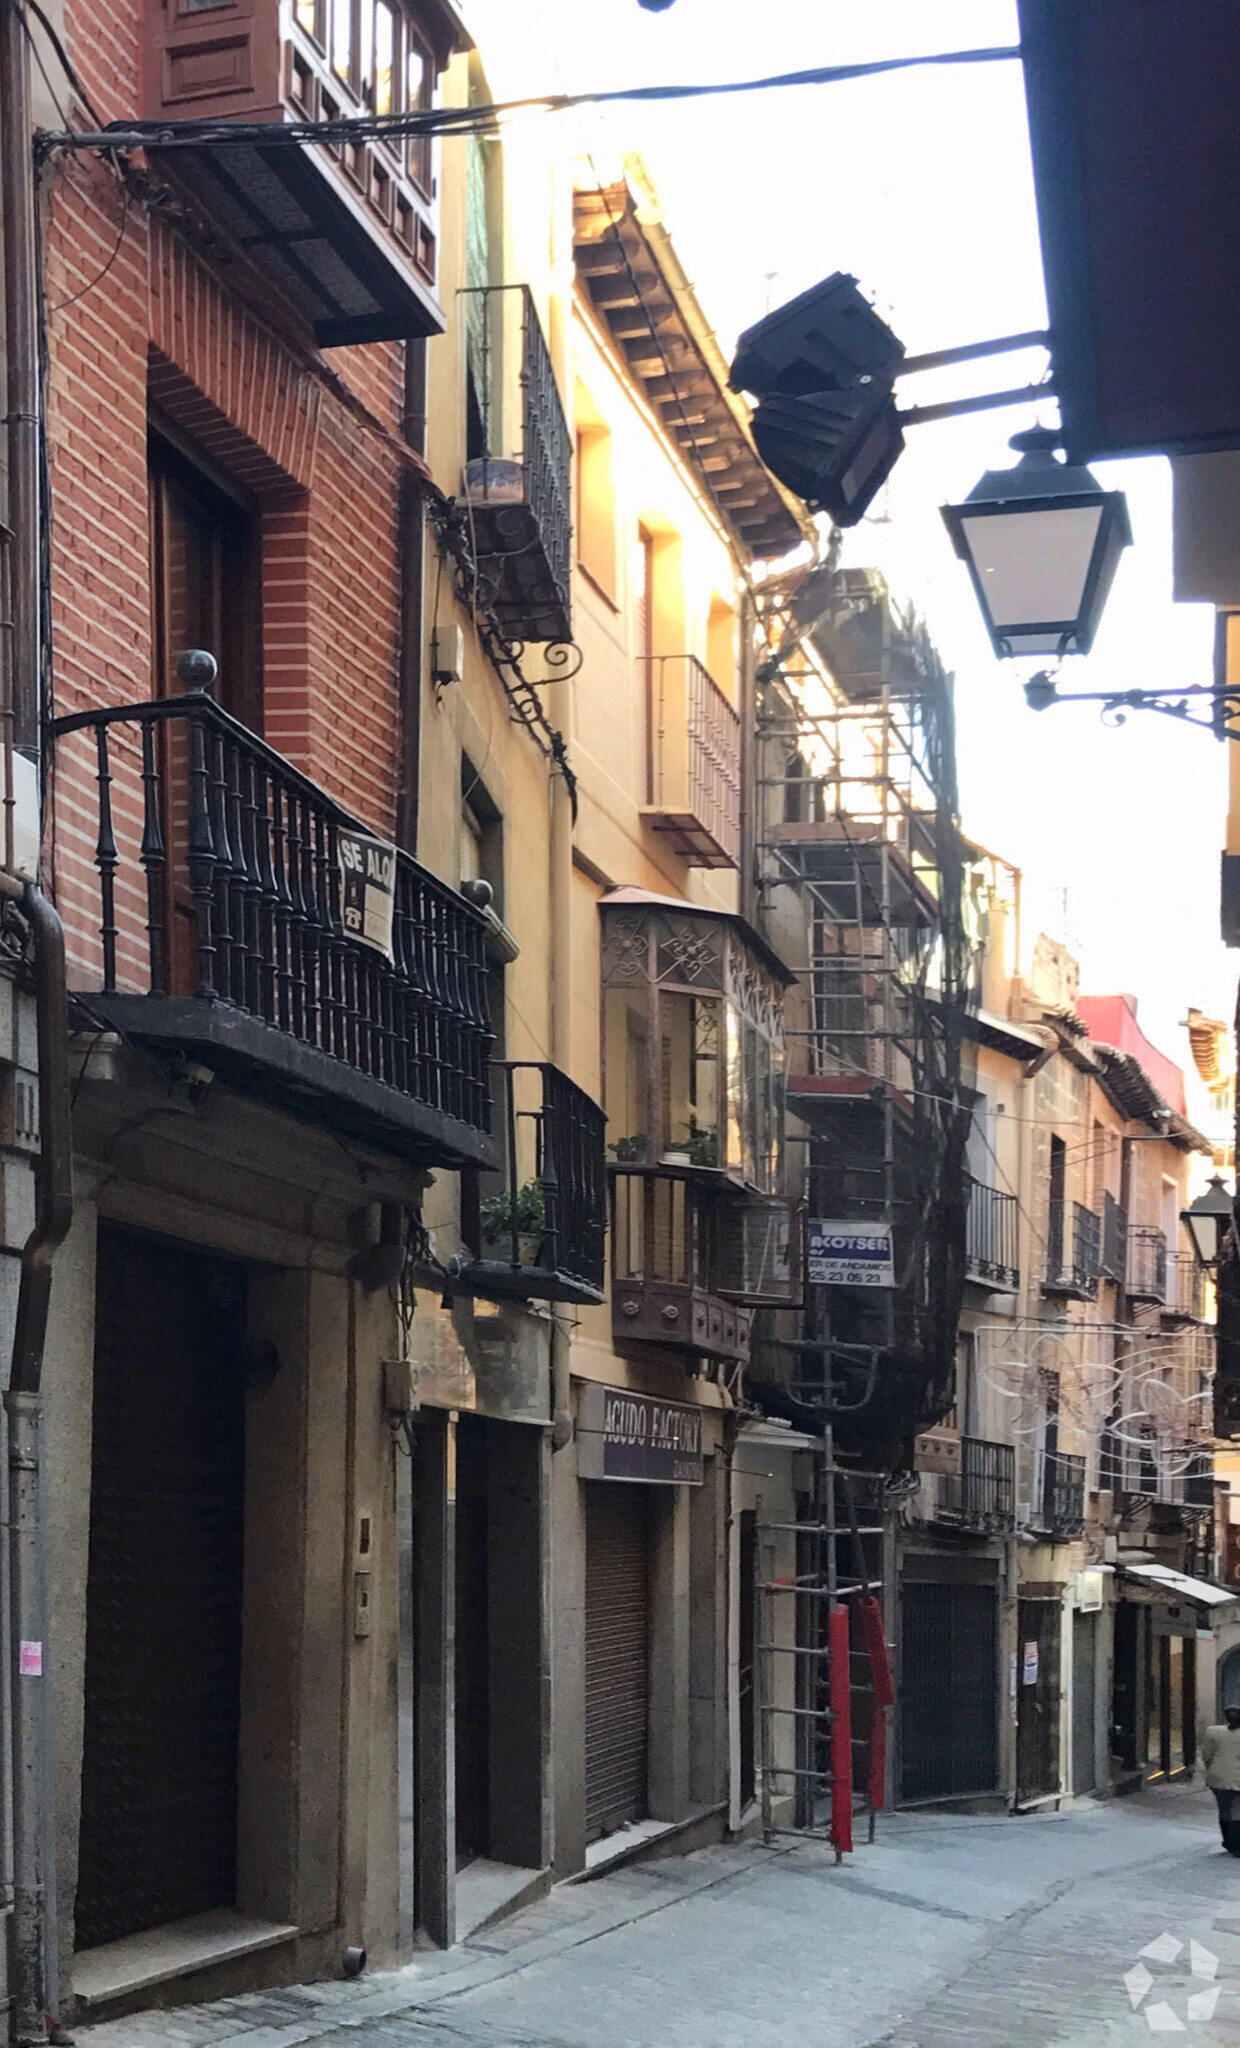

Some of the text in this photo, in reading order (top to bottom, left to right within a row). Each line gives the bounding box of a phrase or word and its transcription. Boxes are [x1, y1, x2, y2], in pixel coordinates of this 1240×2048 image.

[341, 839, 363, 873] SE
[828, 1272, 844, 1282] 23
[847, 1273, 863, 1283] 05
[865, 1274, 881, 1284] 23
[603, 1400, 699, 1453] AGUDO FACTORY
